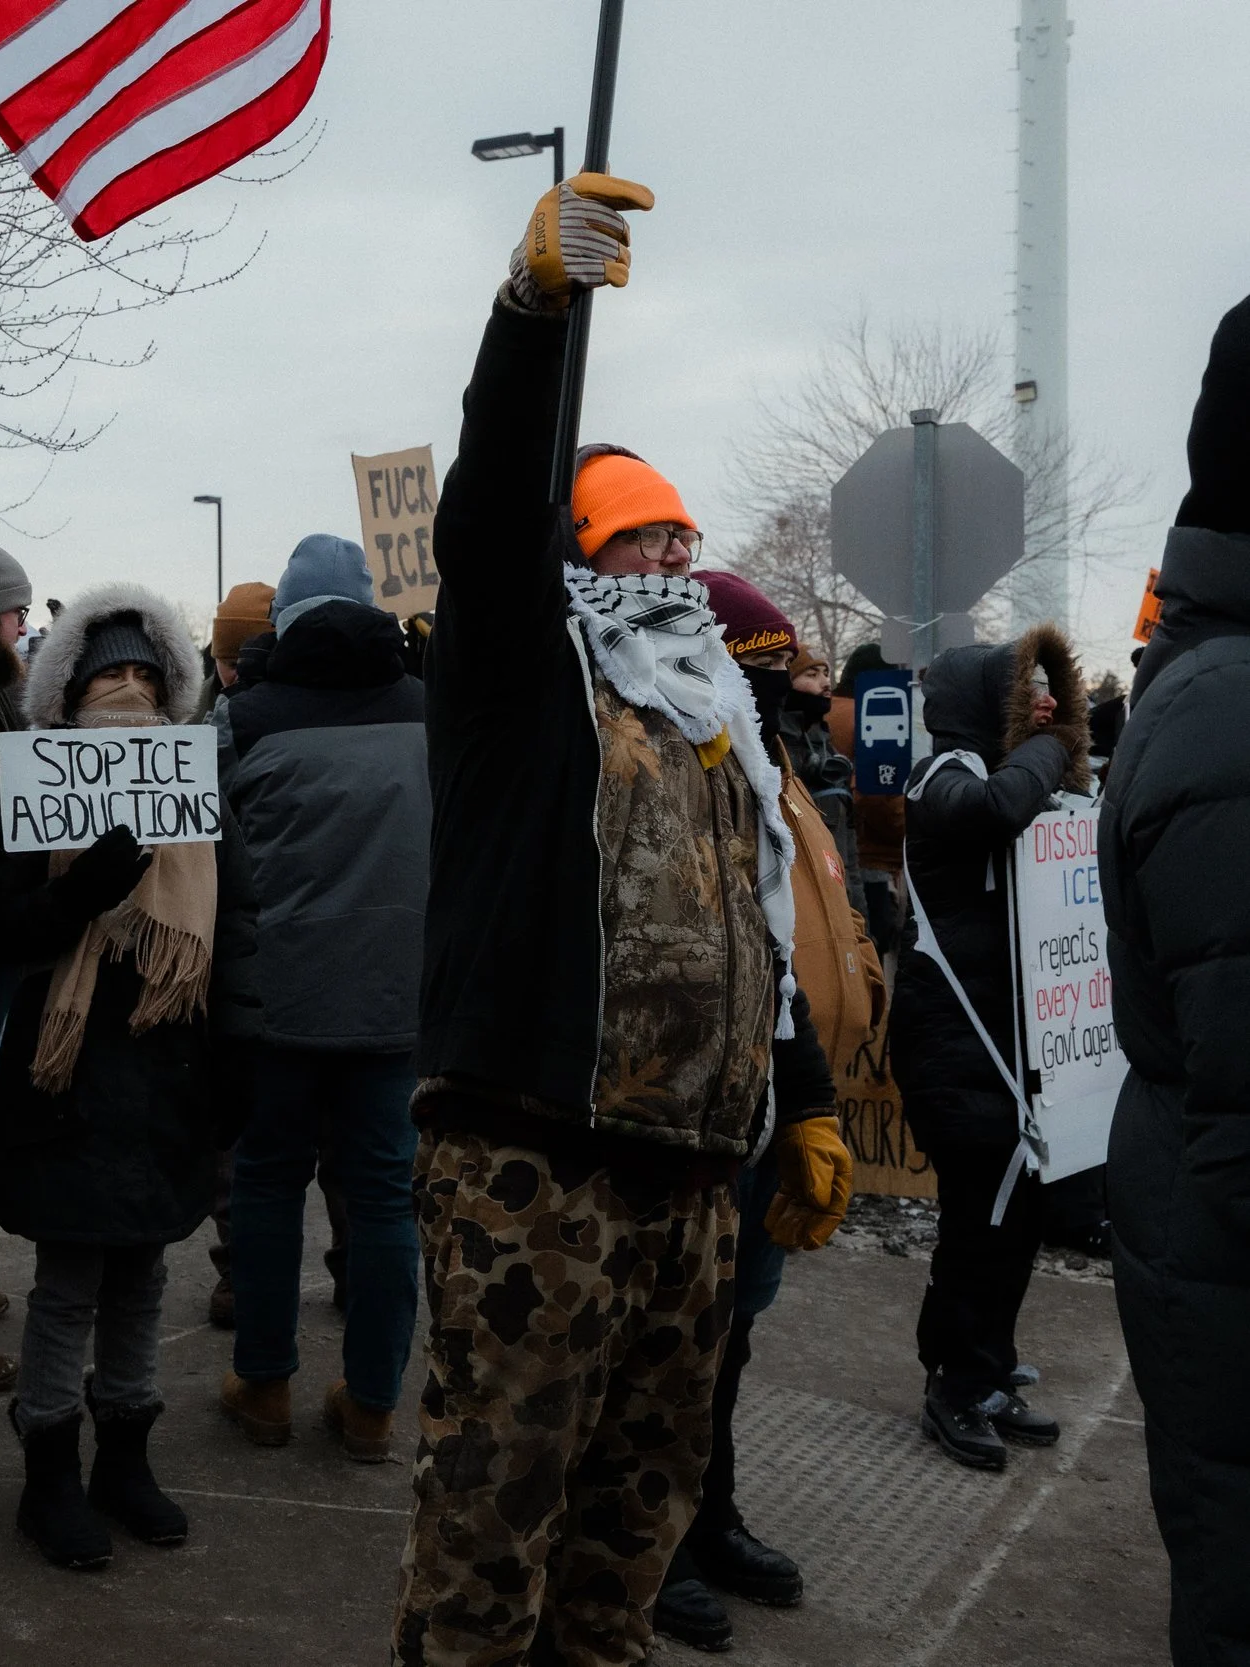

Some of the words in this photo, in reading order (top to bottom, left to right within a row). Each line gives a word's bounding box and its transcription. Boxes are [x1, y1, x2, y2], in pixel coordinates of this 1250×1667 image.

[535, 211, 547, 257] KINCO
[368, 465, 434, 519] FUCK
[375, 526, 439, 597] ICE
[726, 630, 791, 656] Teddies
[33, 738, 126, 789] STOP
[129, 738, 196, 785] ICE
[11, 789, 223, 844] ABDUCTIONS
[1034, 818, 1099, 863] DISSOL
[1039, 922, 1099, 976] rejects
[1036, 981, 1081, 1024] every
[1088, 967, 1113, 1009] oth
[1082, 1021, 1123, 1067] agen
